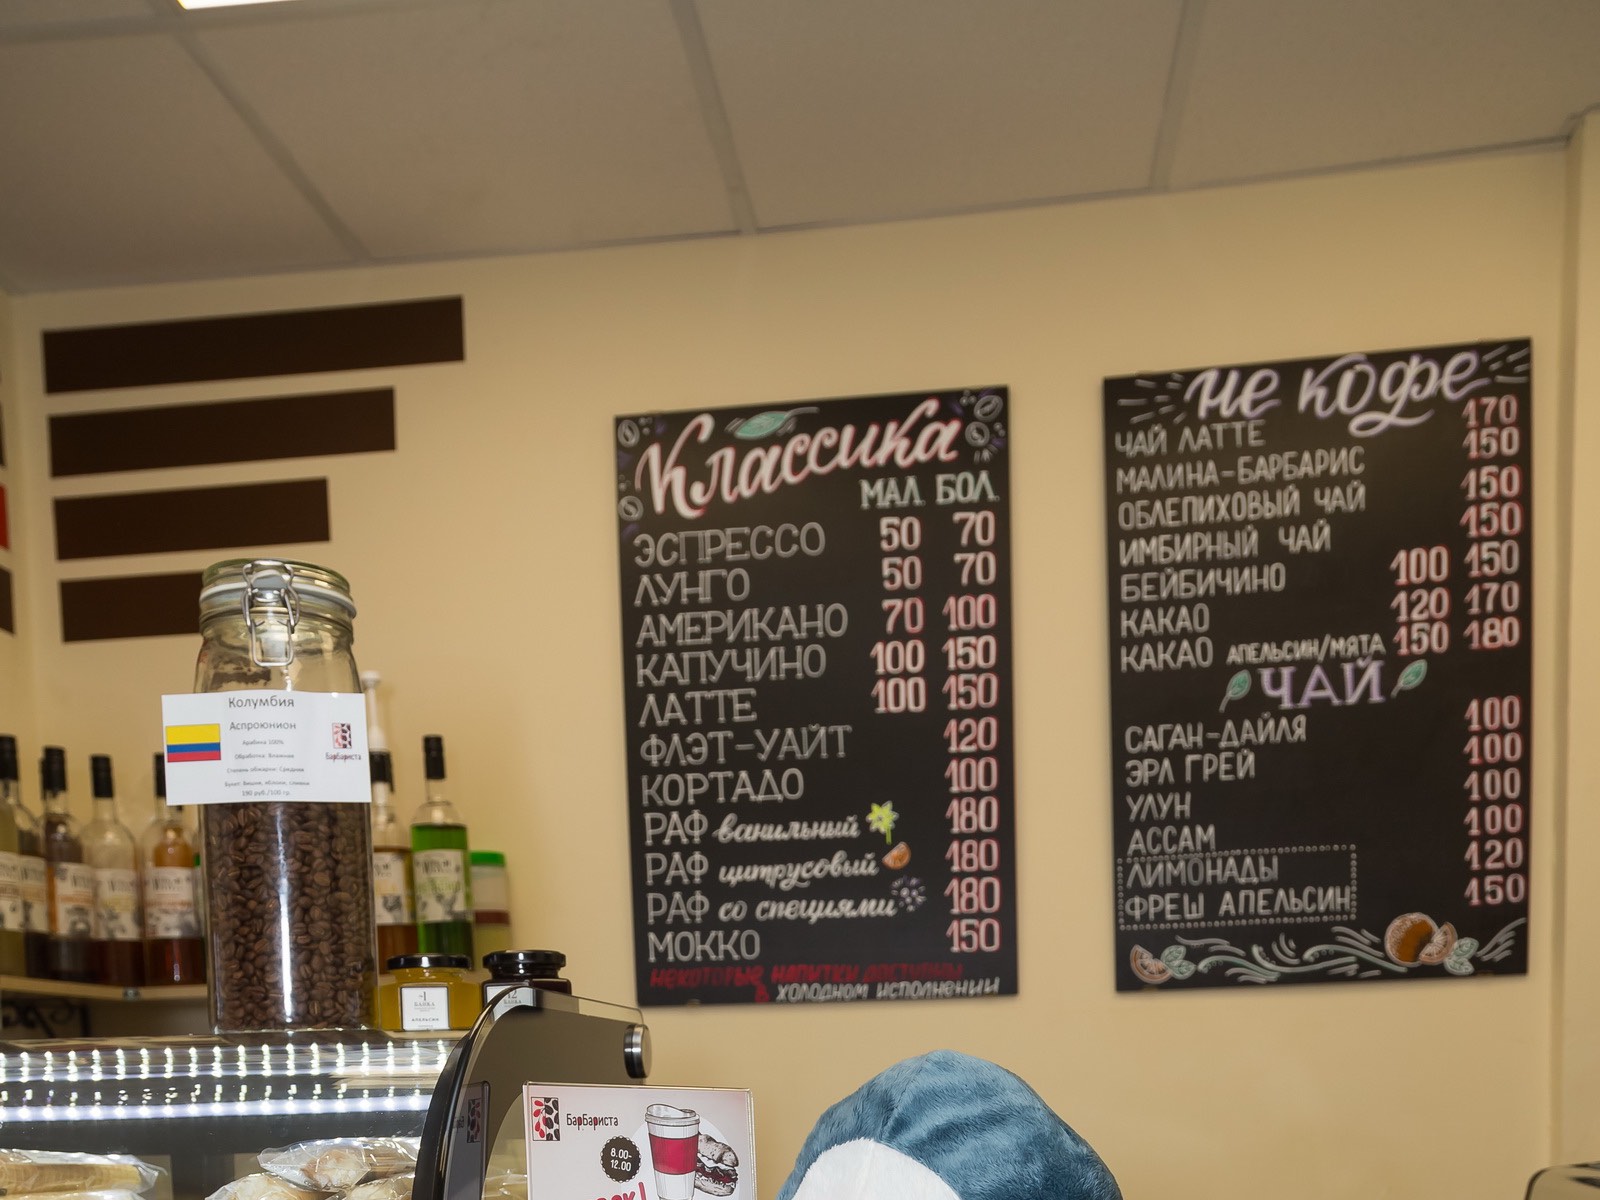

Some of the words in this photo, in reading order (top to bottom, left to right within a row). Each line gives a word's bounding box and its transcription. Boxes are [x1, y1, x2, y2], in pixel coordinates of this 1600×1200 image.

[1115, 424, 1167, 457] ЧАЙ
[1178, 420, 1267, 454] ЛАТТЕ
[1463, 395, 1518, 428] 170
[635, 398, 962, 518] Классика
[1116, 446, 1366, 494] МАЛИНА-БАРБАРИС
[1463, 426, 1520, 459] 150
[1117, 484, 1300, 530] ОБЛЕПИХОВЫЙ
[1314, 480, 1366, 514] ЧАЙ
[1460, 465, 1521, 500] 150
[634, 522, 826, 568] ЭСПРЕССО
[880, 516, 922, 551] 50
[952, 511, 995, 546] 70
[1119, 524, 1259, 567] ИМБИРНЫЙ
[1278, 518, 1332, 554] ЧАЙ
[1460, 502, 1522, 538] 150
[634, 568, 750, 606] ЛУНГО
[881, 555, 922, 591] 50
[954, 551, 996, 586] 70
[1120, 562, 1286, 602] БЕЙБИЧИНО
[1391, 546, 1450, 586] 100
[1463, 540, 1520, 577] 150
[636, 603, 849, 647] АМЕРИКАНО
[882, 597, 924, 634] 70
[942, 594, 997, 631] 100
[1120, 604, 1211, 638] КАКАО
[1391, 587, 1450, 623] 120
[1463, 581, 1520, 615] 170
[636, 644, 826, 686] КАПУЧИНО
[870, 640, 925, 676] 100
[942, 634, 997, 671] 150
[1120, 637, 1214, 672] КАКАО
[1226, 633, 1385, 665] АПЕЛЬСИН/МЯТА
[1393, 620, 1450, 656] 150
[1463, 616, 1520, 651] 180
[228, 695, 294, 709] Колумбия
[639, 687, 757, 727] ЛАТТЕ
[871, 675, 927, 715] 100
[942, 671, 998, 711] 150
[1258, 658, 1385, 710] ЧАЙ
[230, 721, 296, 730] Аспроюнион
[639, 724, 853, 767] ФЛЭТ-УАЙТ
[943, 716, 998, 753] 120
[1124, 712, 1307, 754] САГАН-ДАЙЛЯ
[1464, 695, 1521, 732] 100
[640, 768, 804, 806] КОРТАДО
[944, 756, 998, 794] 100
[1125, 757, 1175, 787] ЭРЛ
[1186, 748, 1255, 784] ГРЕЙ
[1463, 732, 1523, 765] 100
[644, 809, 708, 846] РАФ
[713, 813, 861, 843] ванильный
[946, 796, 998, 834] 180
[1125, 792, 1192, 822] УЛУН
[1463, 767, 1522, 802] 100
[1127, 824, 1216, 856] АССАМ
[1463, 803, 1523, 836] 100
[645, 851, 708, 885] РАФ
[719, 850, 879, 891] цитрусовый
[946, 839, 999, 873] 180
[1127, 855, 1279, 888] ЛИМОНАДЫ
[1464, 838, 1523, 872] 120
[646, 891, 710, 924] РАФ
[719, 901, 747, 922] со
[755, 898, 898, 924] специями
[944, 877, 1000, 915] 180
[1124, 893, 1205, 922] ФРЕШ
[1218, 886, 1352, 917] АПЕЛЬСИН
[1464, 873, 1526, 906] 150
[647, 930, 761, 963] МОККО
[946, 918, 1000, 954] 150
[611, 1160, 631, 1172] 12.00
